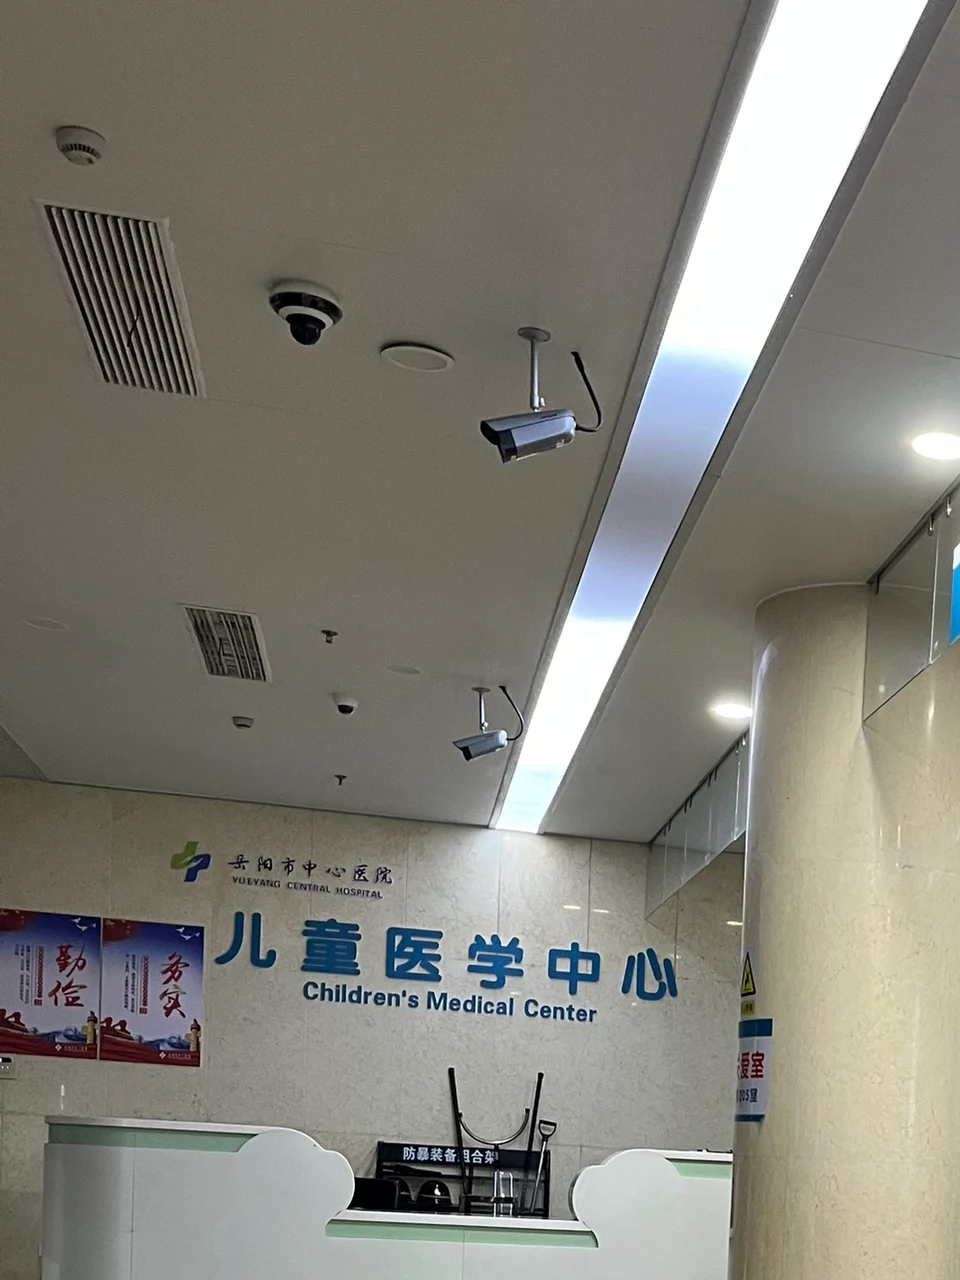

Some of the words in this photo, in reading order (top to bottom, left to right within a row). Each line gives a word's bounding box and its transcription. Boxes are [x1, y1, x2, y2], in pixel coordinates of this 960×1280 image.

[228, 854, 393, 885] 岳阳市中心医院
[232, 876, 281, 888] YUEYANG
[287, 881, 331, 894] CENTRAL
[335, 887, 383, 899] HOSPITAL
[214, 911, 678, 1001] 儿童医学中心
[302, 981, 419, 1008] Children's
[426, 991, 514, 1016] Medical
[523, 998, 597, 1023] Center
